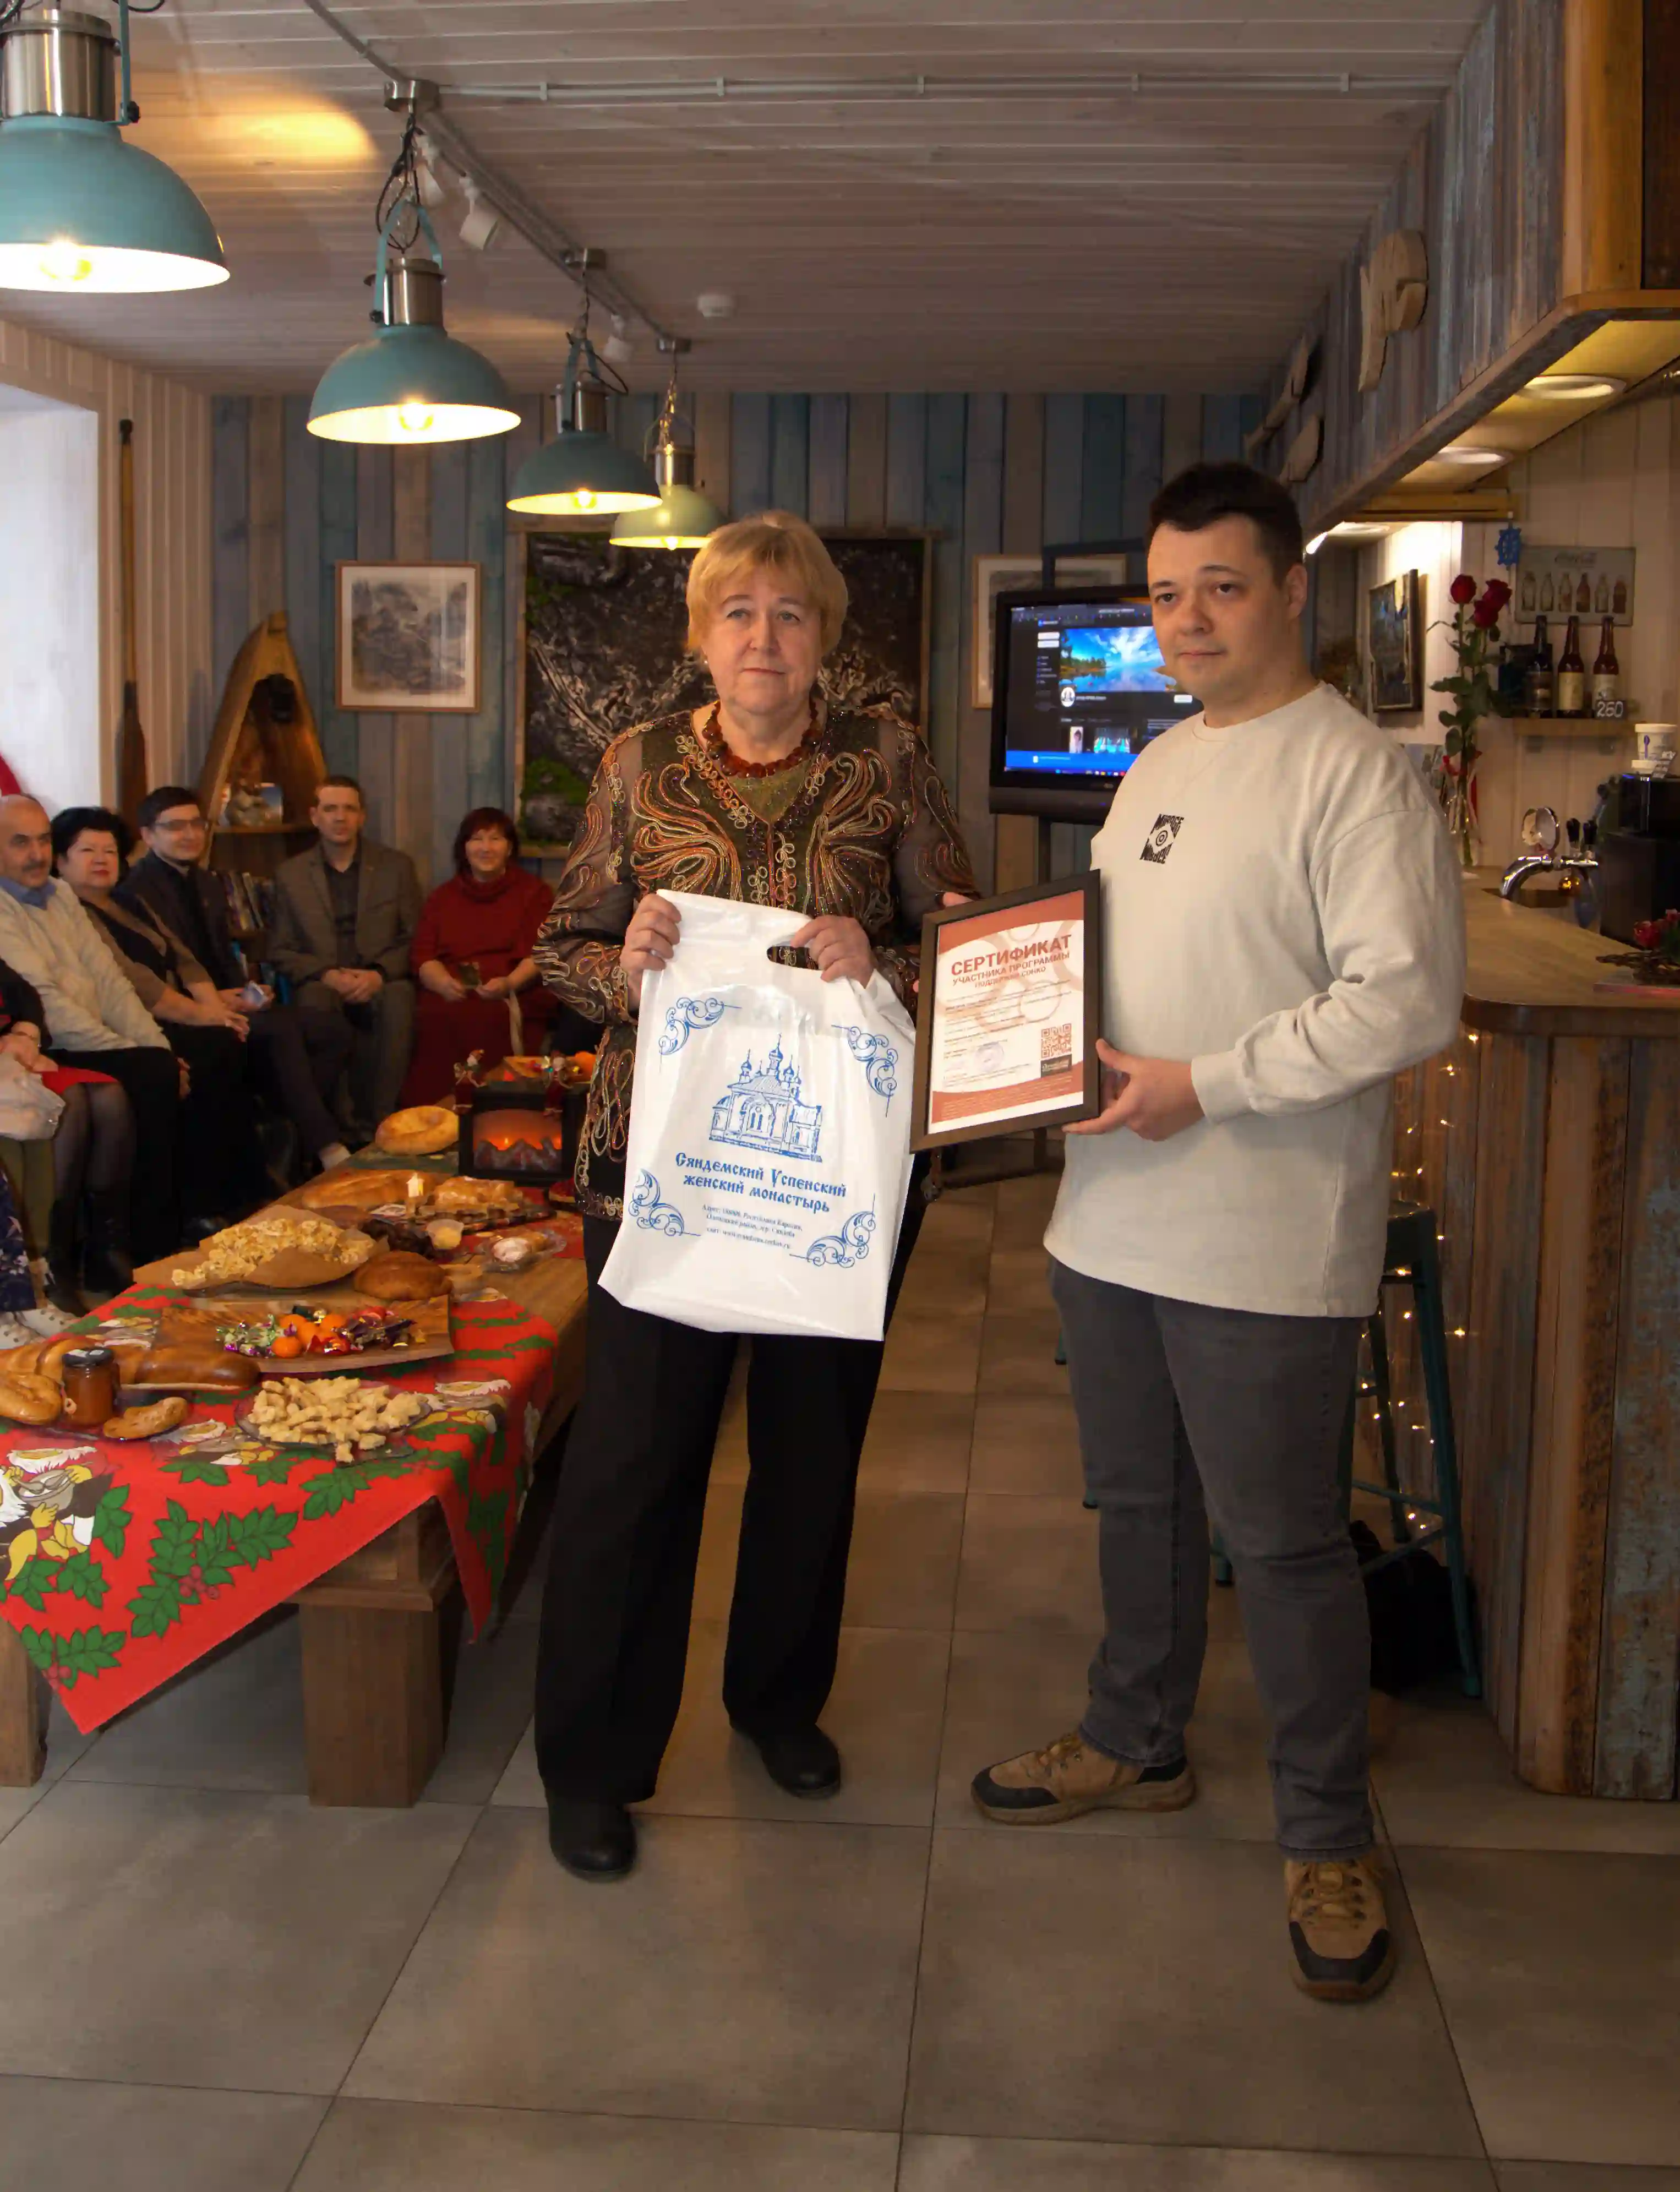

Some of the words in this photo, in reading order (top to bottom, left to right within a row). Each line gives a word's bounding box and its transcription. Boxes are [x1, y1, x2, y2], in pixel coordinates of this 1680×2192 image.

[1597, 701, 1623, 718] 260
[951, 934, 1071, 975] СЕРТИФИКАТ
[953, 968, 1006, 986] УЧАСТНИКА
[1009, 951, 1070, 972] ПРОГРАММЫ
[675, 1152, 764, 1181] Сяндемский
[771, 1168, 848, 1197] Успенский
[683, 1174, 744, 1195] женский
[749, 1186, 830, 1214] монастырь
